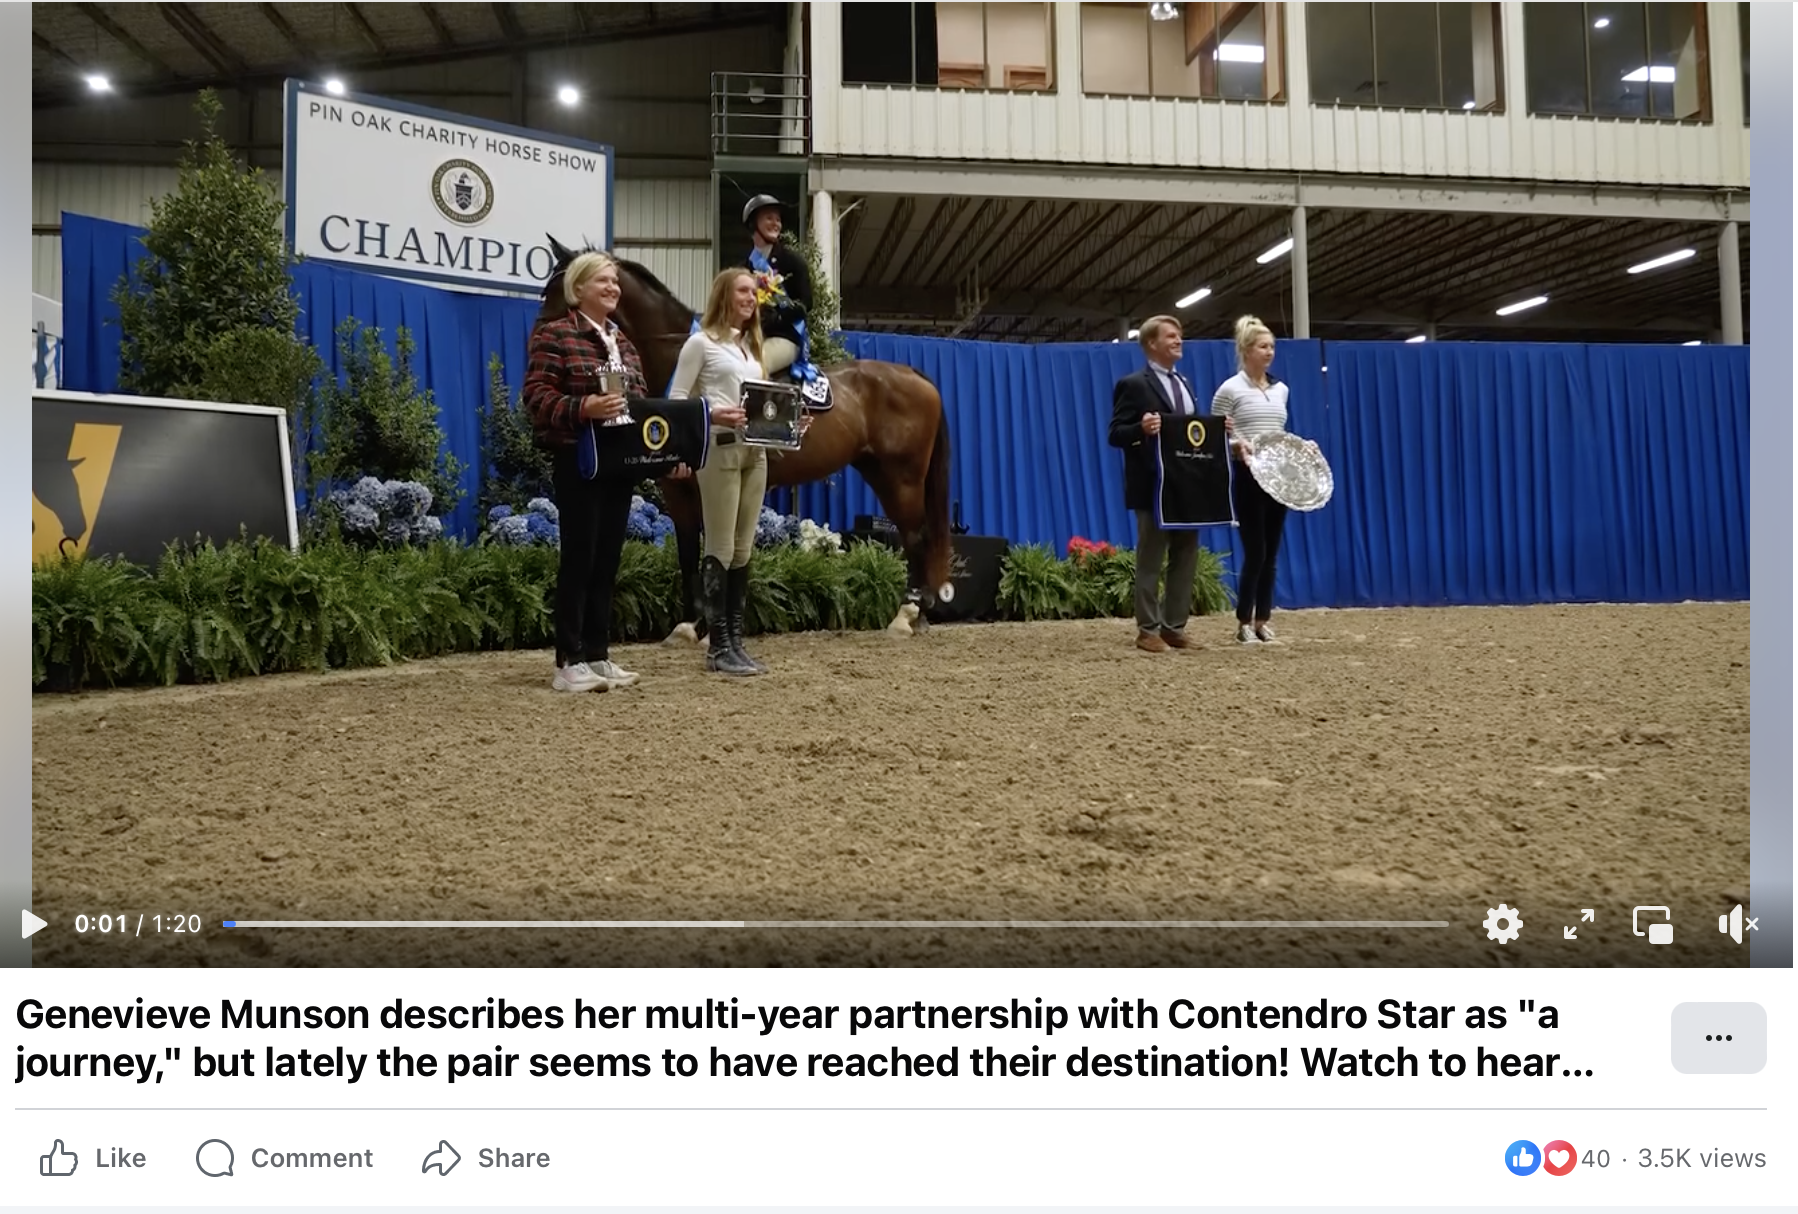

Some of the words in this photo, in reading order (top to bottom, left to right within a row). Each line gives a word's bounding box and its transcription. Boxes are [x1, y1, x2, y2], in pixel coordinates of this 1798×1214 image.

[309, 102, 342, 123] PIN
[351, 111, 392, 133] OAK
[399, 120, 479, 149] CHARITY
[485, 137, 542, 163] HORSE
[548, 150, 597, 173] SHOW
[320, 214, 555, 281] CHAMPIO
